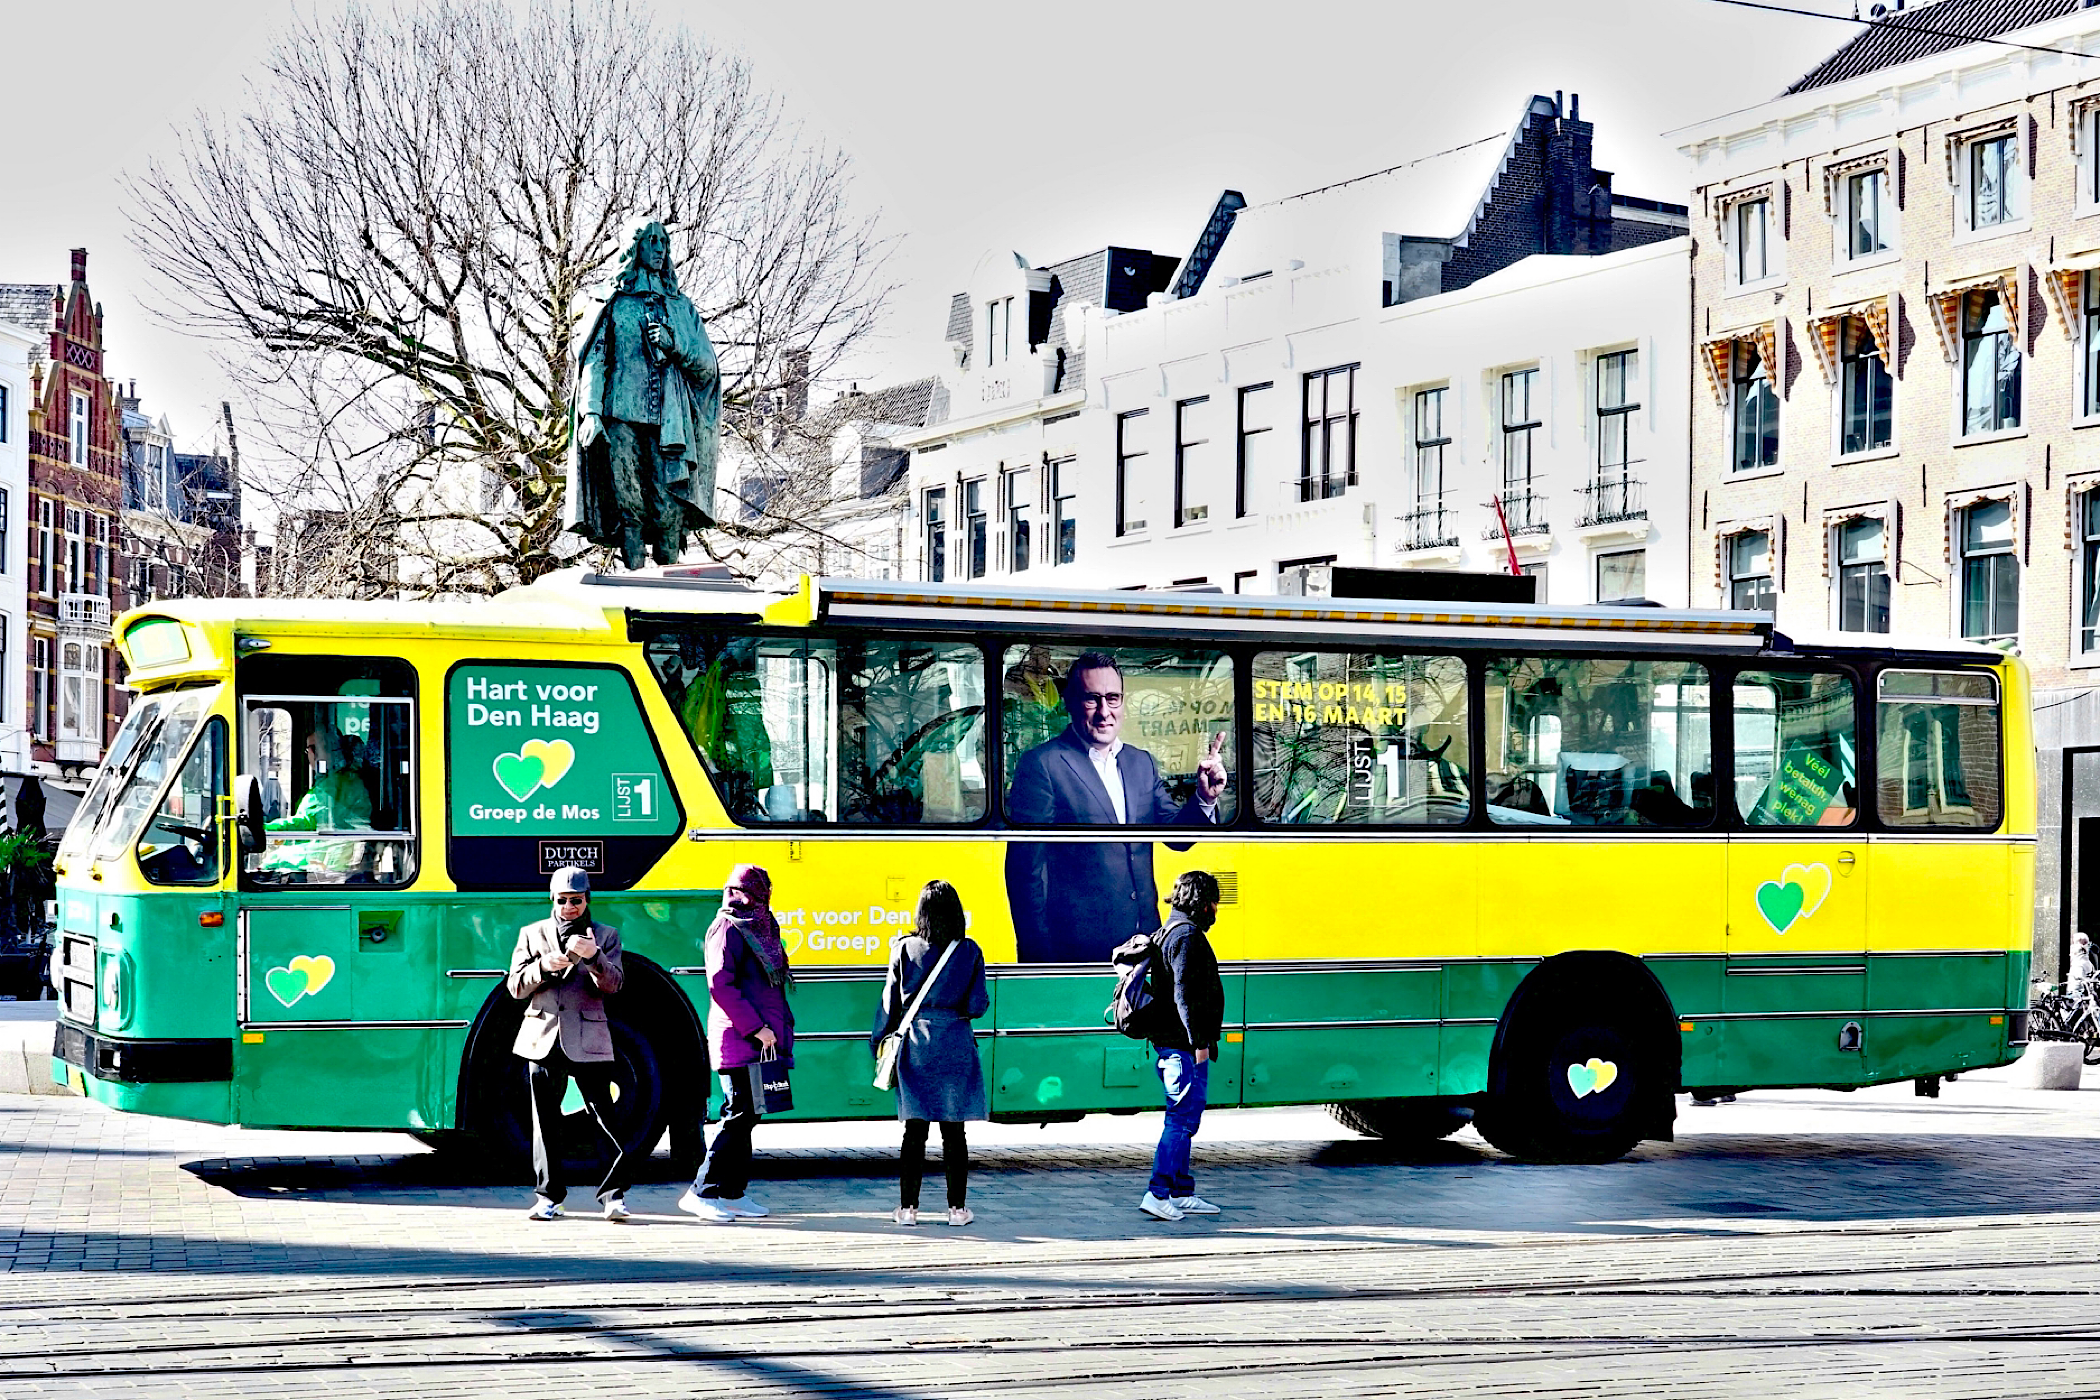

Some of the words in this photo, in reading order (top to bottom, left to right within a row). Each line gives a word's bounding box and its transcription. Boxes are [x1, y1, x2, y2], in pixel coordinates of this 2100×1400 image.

[466, 677, 528, 701] Hart
[536, 684, 598, 701] voor
[1254, 680, 1313, 700] STEM
[1318, 683, 1348, 700] OP
[1352, 684, 1380, 705] 14,
[1385, 685, 1407, 703] 15
[467, 703, 521, 726] Den
[531, 704, 600, 733] Haag
[1255, 703, 1284, 722] EN
[1292, 705, 1316, 723] 16
[1323, 706, 1407, 726] MAART
[1354, 741, 1373, 801] LIJST
[1376, 744, 1401, 802] 1
[617, 778, 631, 817] LIJST
[633, 778, 651, 815] 1
[469, 804, 528, 823] Groep
[533, 804, 556, 820] de
[562, 805, 600, 820] Mos
[545, 847, 598, 860] DUTCH
[548, 860, 595, 868] PARTIKELS
[770, 906, 806, 925] art
[812, 910, 863, 925] voor
[868, 905, 912, 925] Den
[807, 929, 881, 956] Groep
